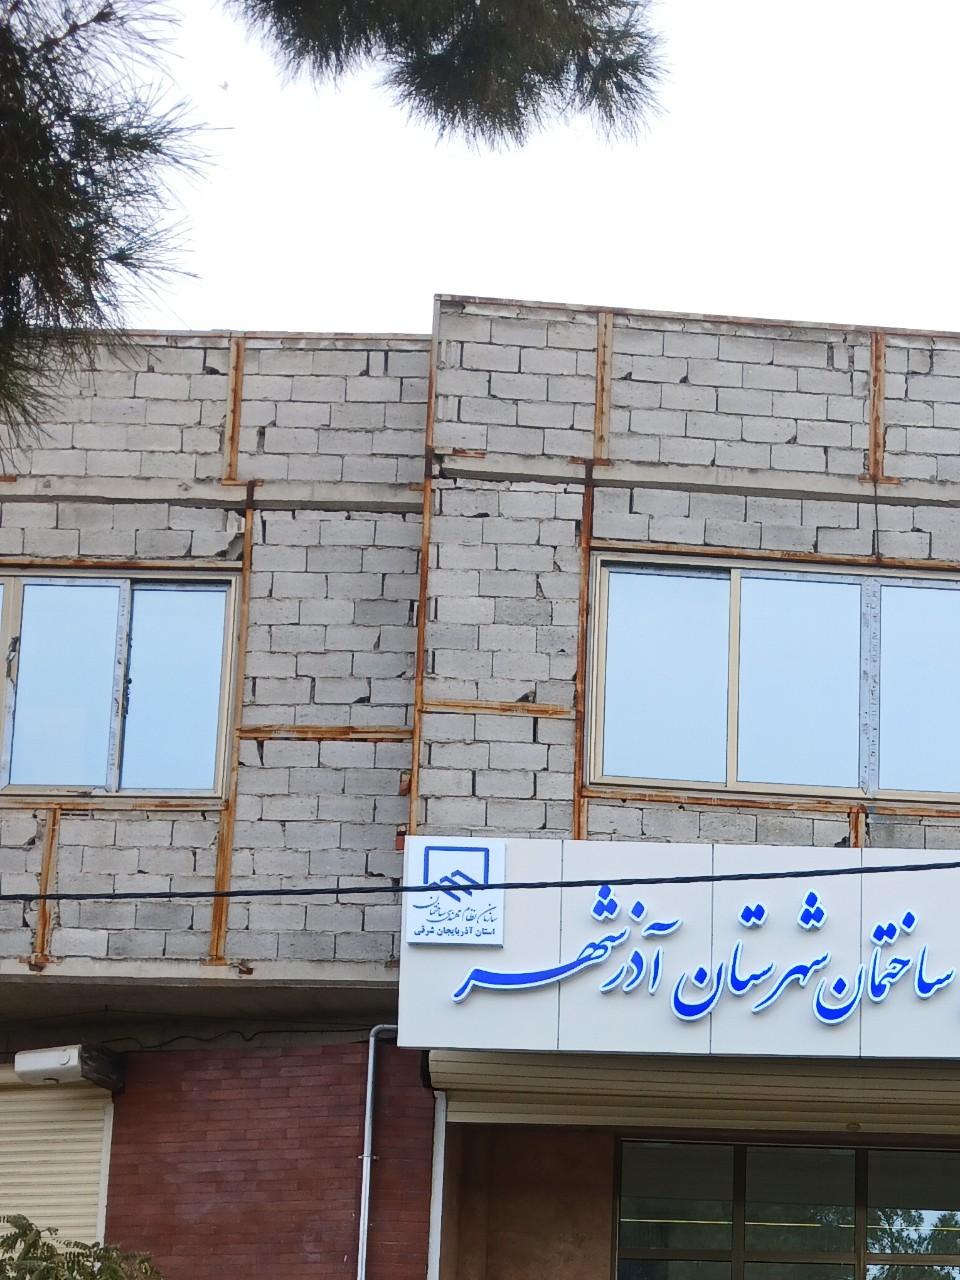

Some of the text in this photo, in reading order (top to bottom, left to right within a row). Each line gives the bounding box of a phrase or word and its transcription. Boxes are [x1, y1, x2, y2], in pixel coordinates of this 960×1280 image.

[413, 925, 496, 937] استان آذربایجان شرقی
[451, 884, 684, 1005] آذرشهر
[461, 907, 477, 922] نظام
[670, 888, 832, 1023] شهرستان
[811, 908, 956, 1025] ساختمان
